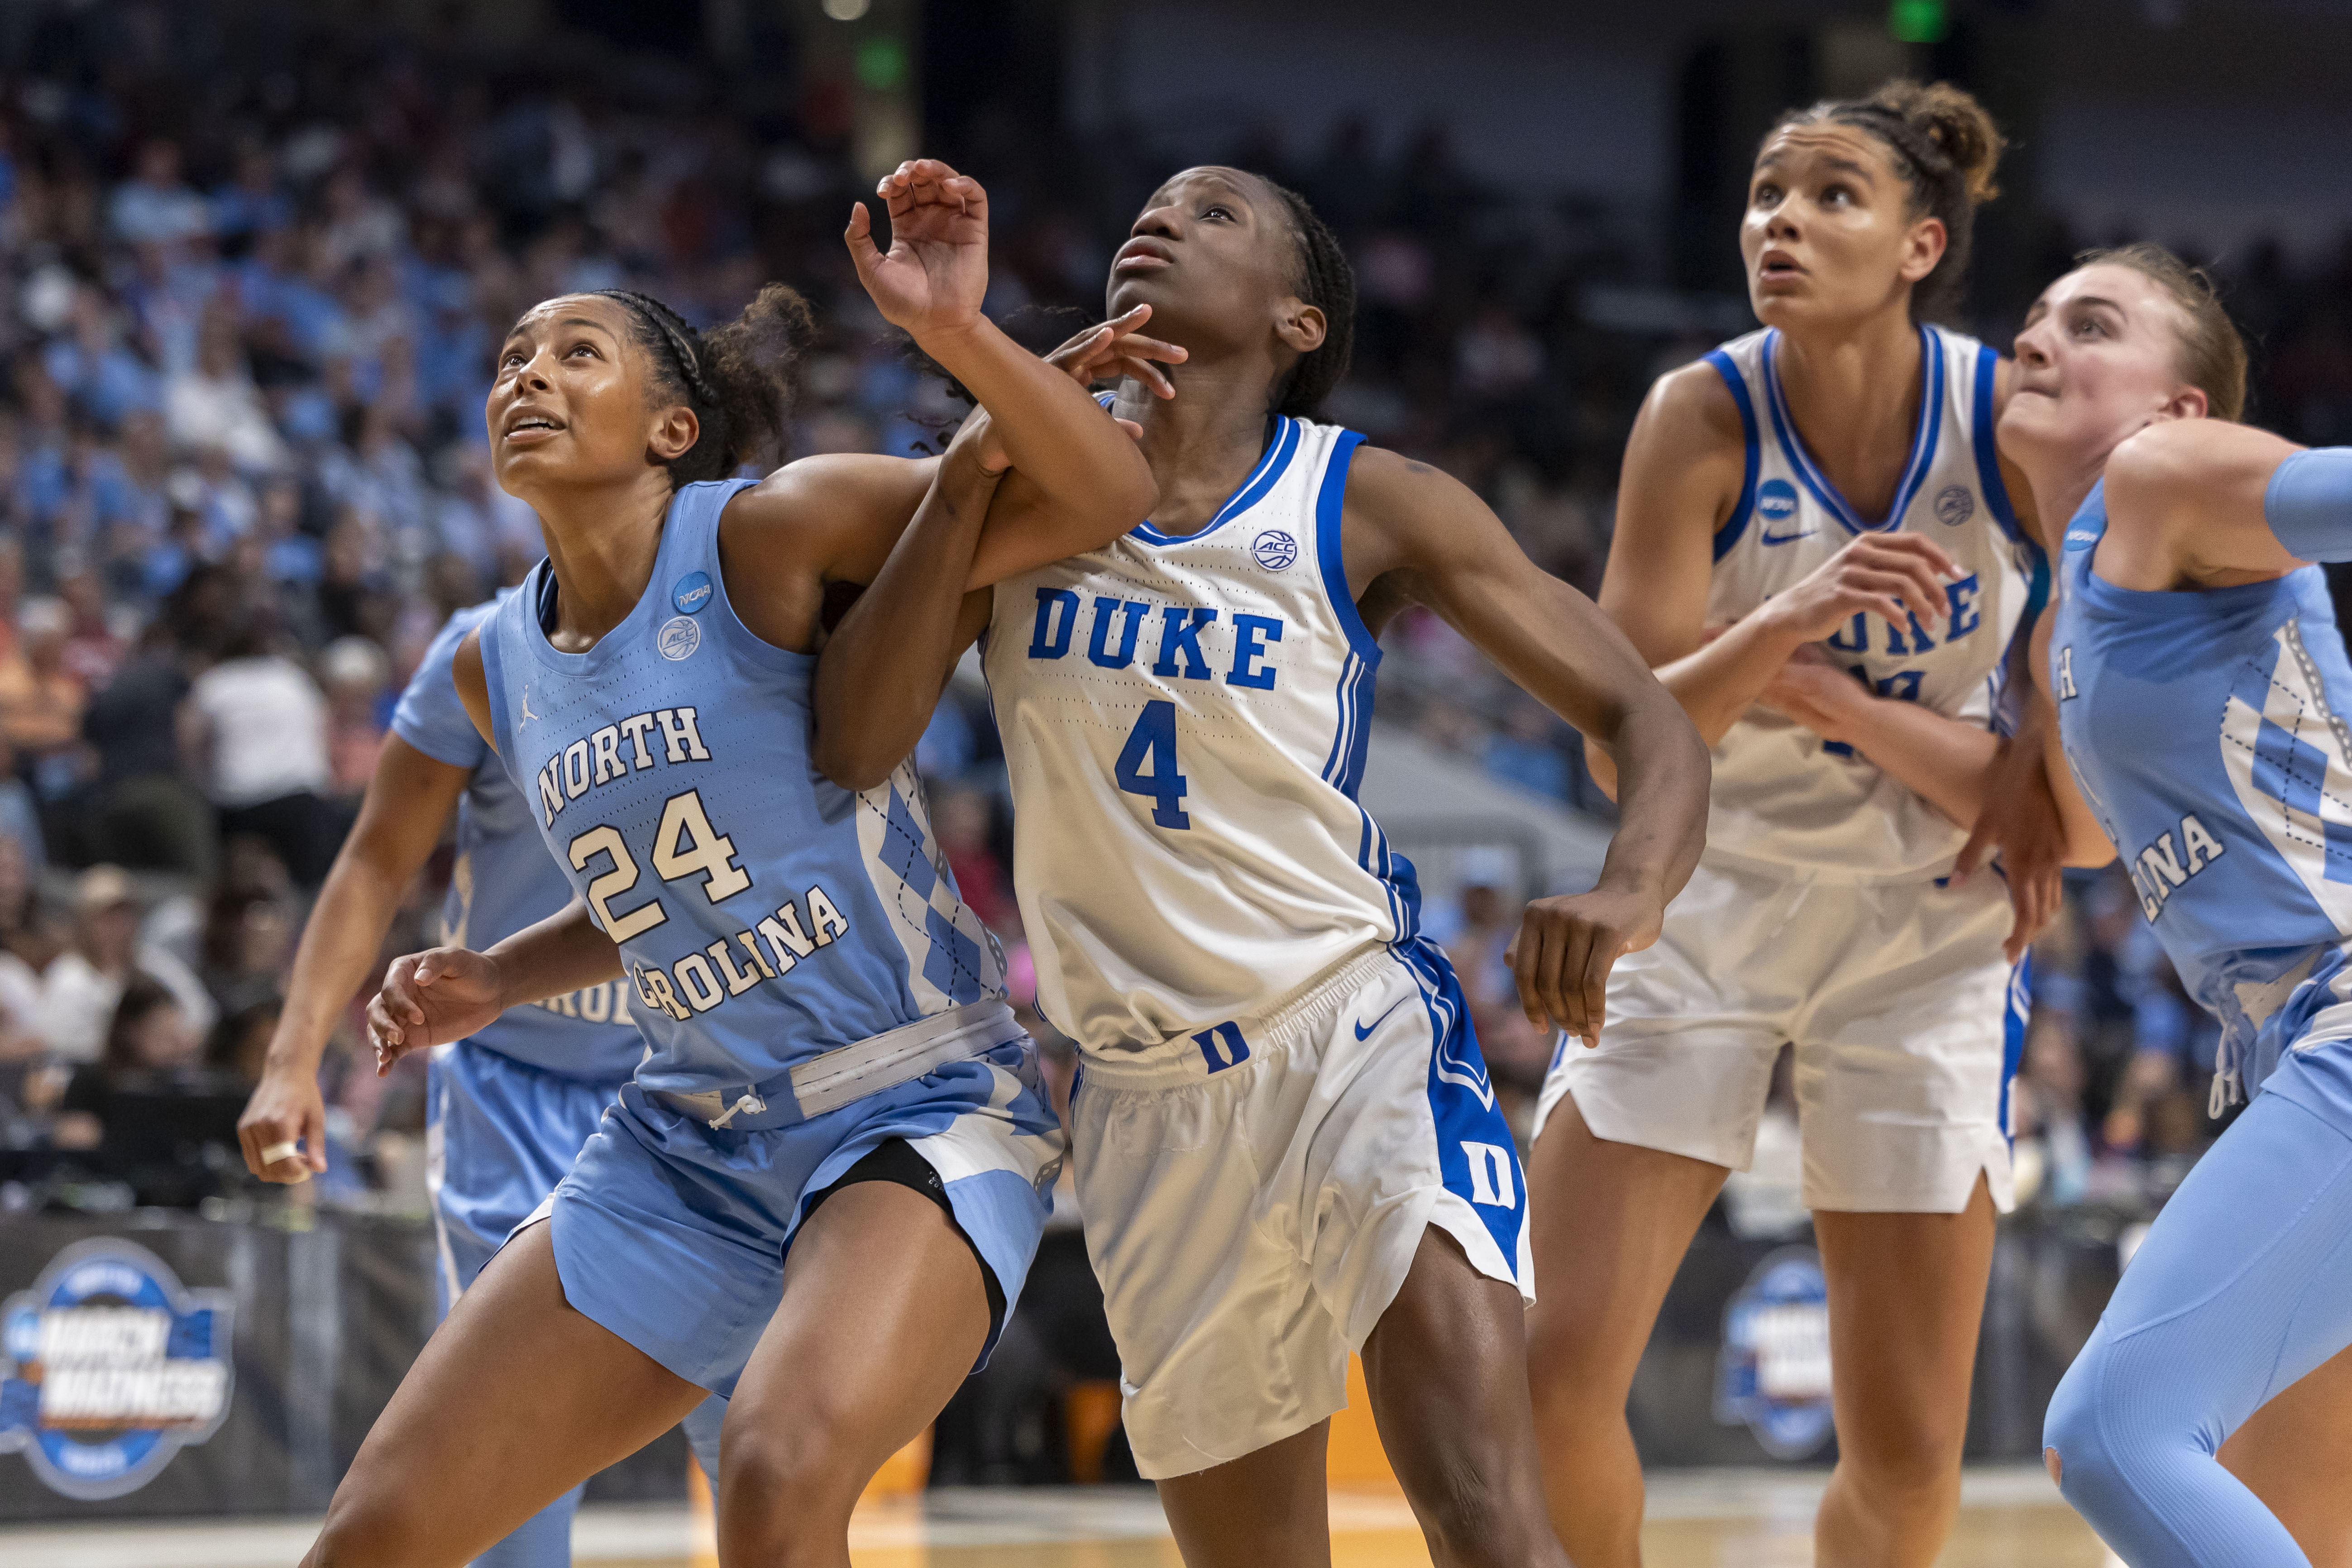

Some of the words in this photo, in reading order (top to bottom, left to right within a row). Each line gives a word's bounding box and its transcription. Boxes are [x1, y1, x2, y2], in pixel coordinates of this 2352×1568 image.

[679, 584, 711, 607] NCAA
[1258, 541, 1296, 552] ACC
[665, 625, 696, 645] ACC
[1028, 587, 1284, 691] DUKE
[1827, 572, 1980, 655] UKE
[537, 706, 712, 830] NORTH
[1114, 699, 1191, 830] 4
[567, 787, 754, 945] 24
[632, 884, 850, 1022] CROLINA
